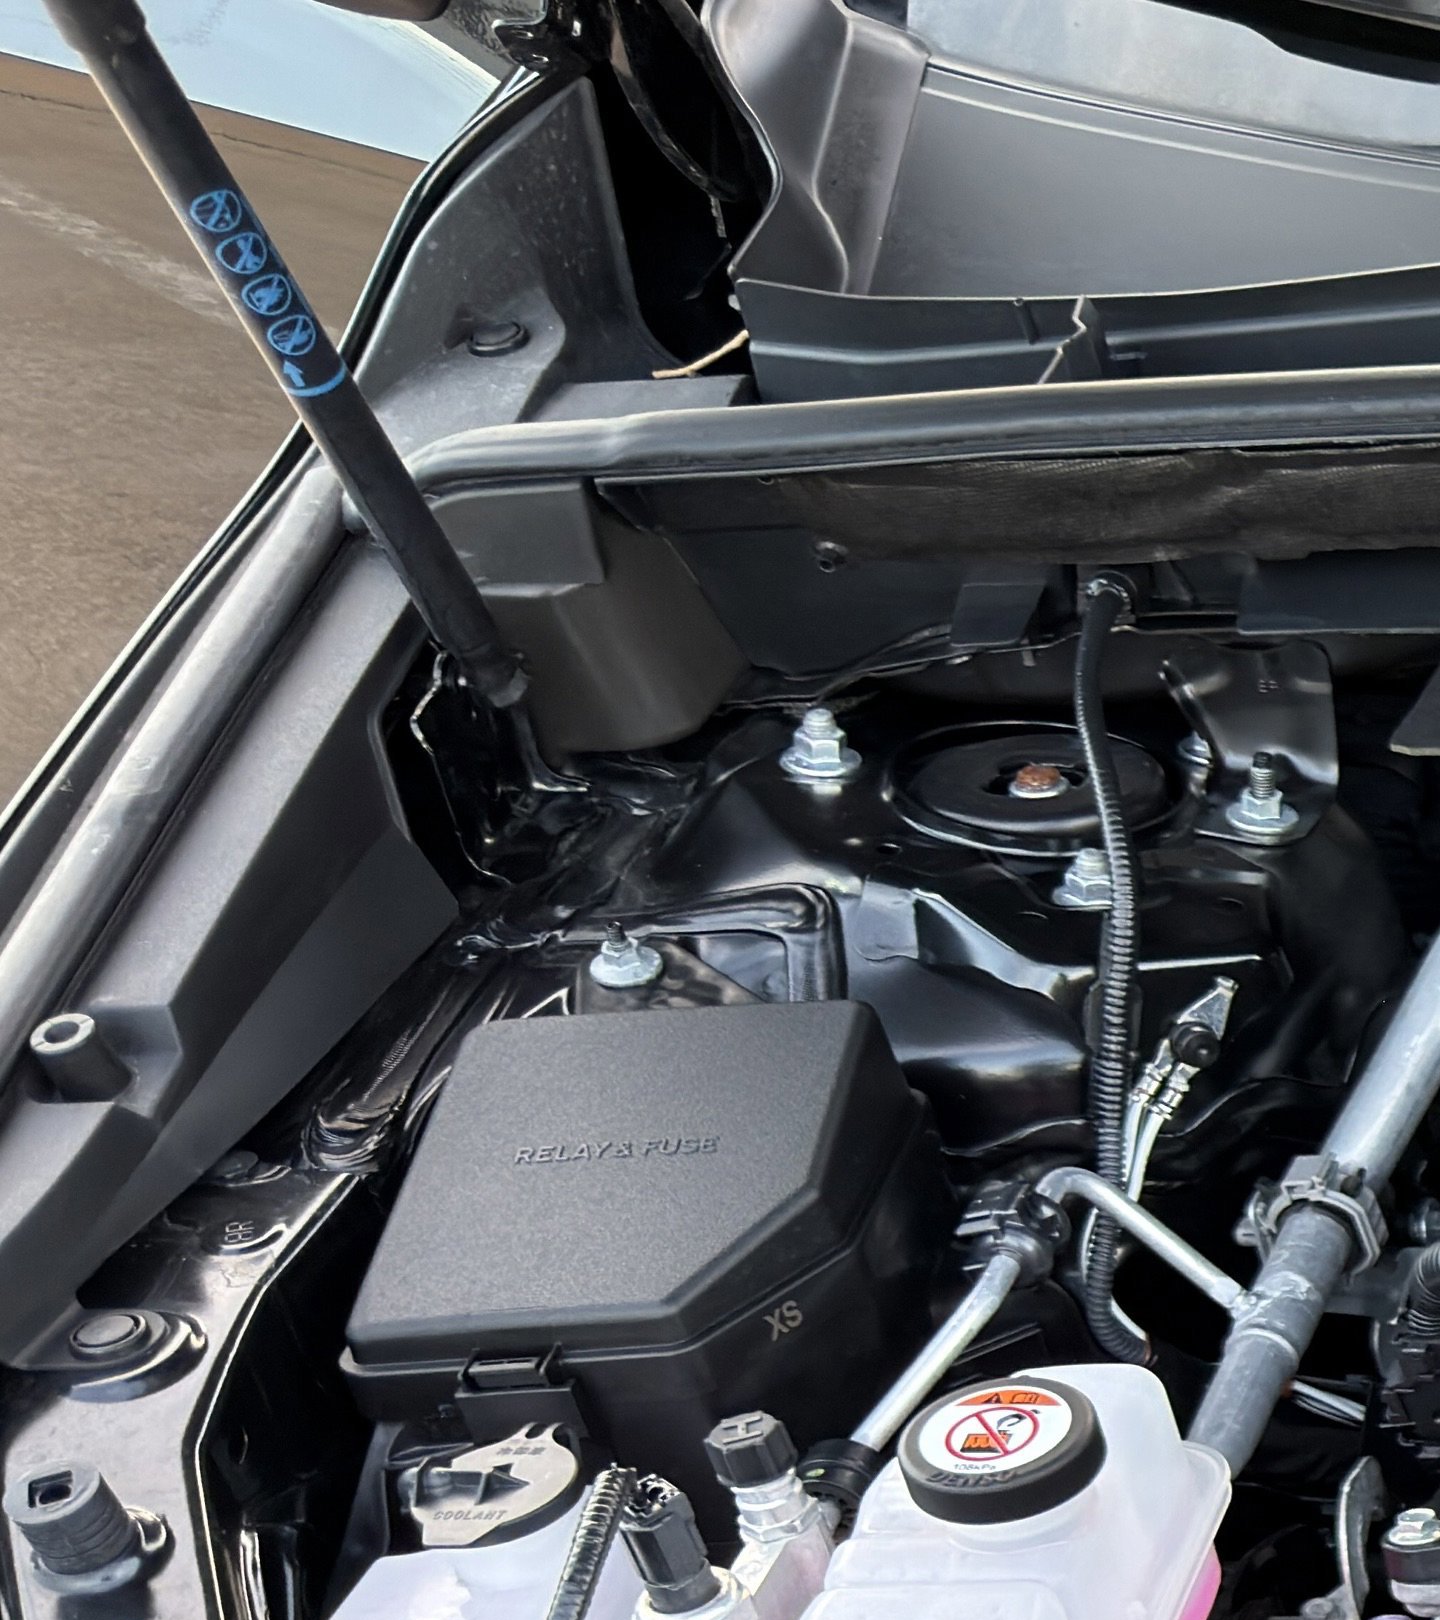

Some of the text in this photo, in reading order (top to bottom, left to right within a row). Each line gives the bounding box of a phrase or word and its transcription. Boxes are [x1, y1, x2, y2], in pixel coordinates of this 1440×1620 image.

[513, 1141, 612, 1164] RELAY
[643, 1136, 721, 1157] FUSE
[760, 1300, 804, 1341] XS
[432, 1509, 509, 1522] COOLANT
